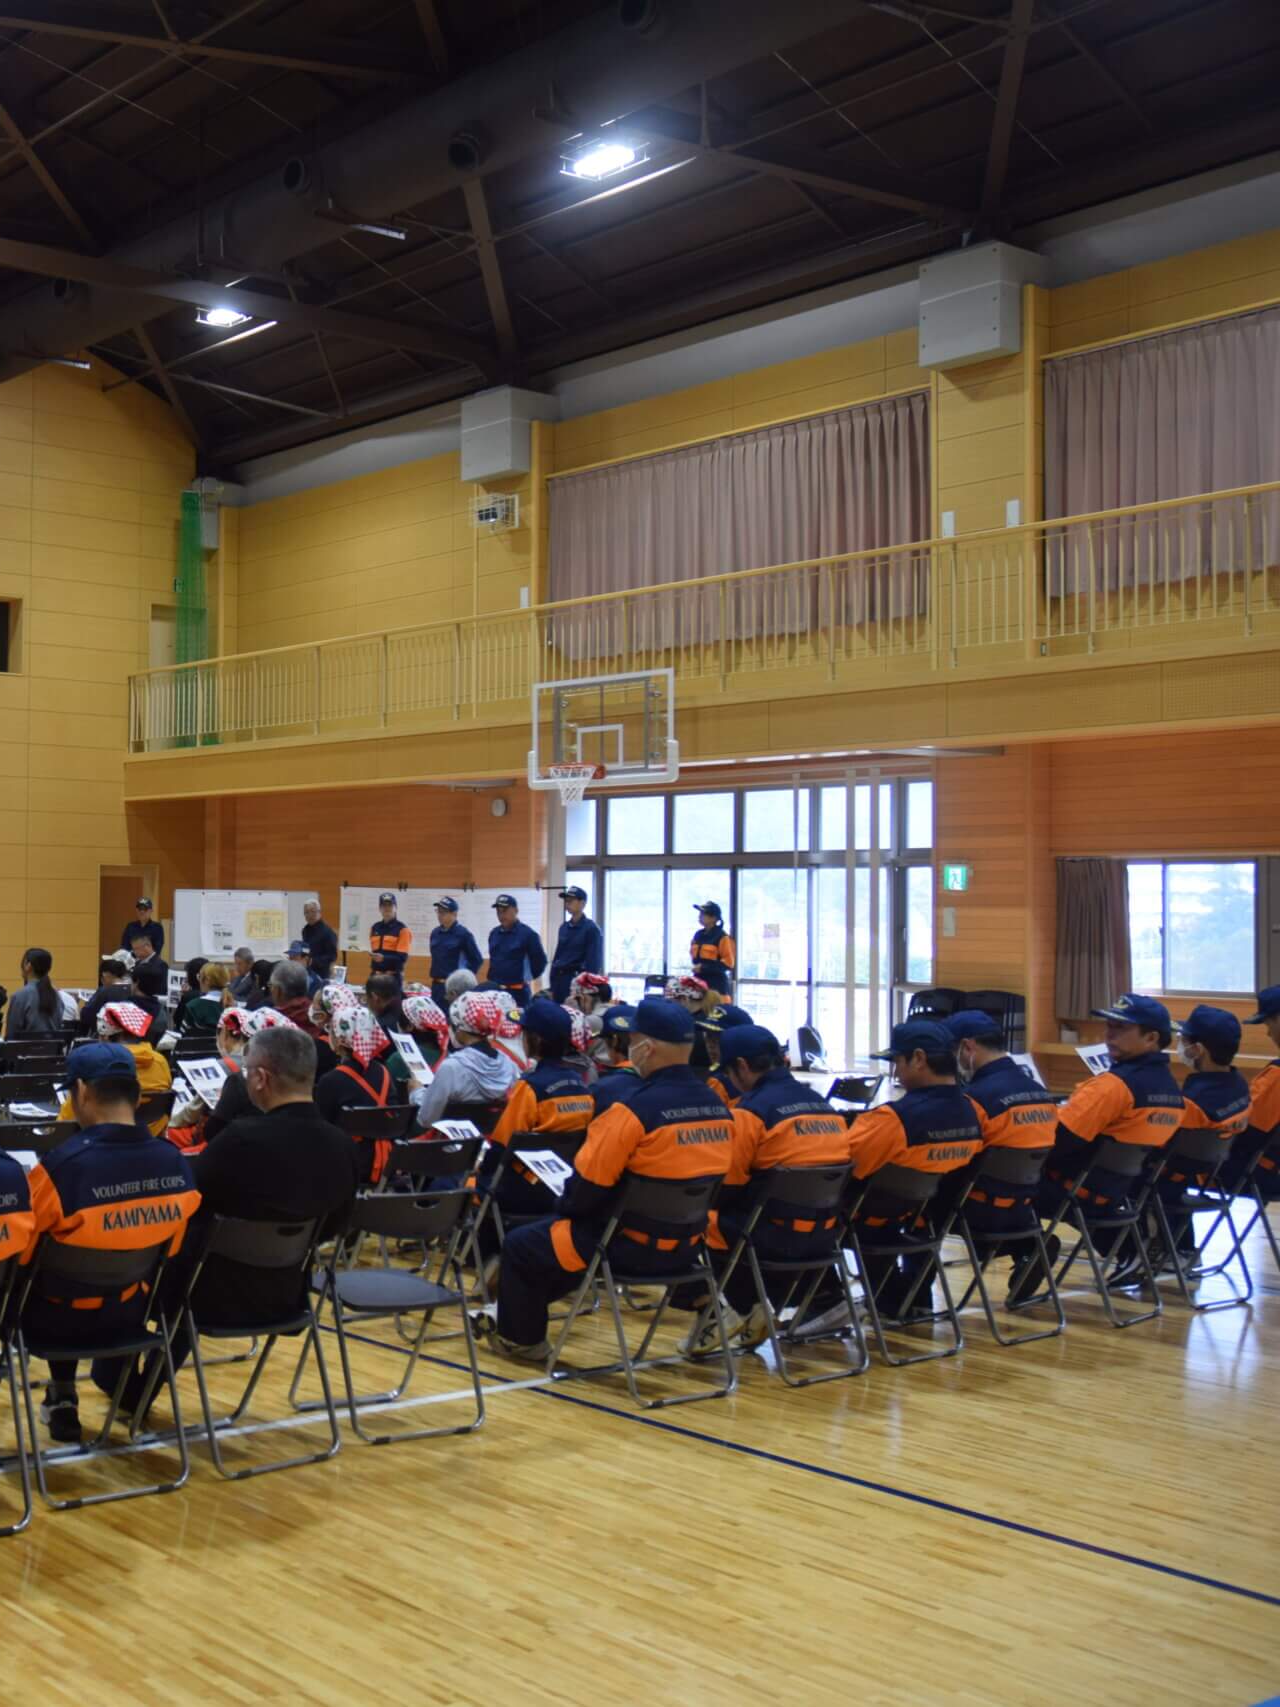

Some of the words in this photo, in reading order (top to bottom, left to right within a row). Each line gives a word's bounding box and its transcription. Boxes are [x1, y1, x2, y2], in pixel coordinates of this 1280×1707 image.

[677, 1126, 729, 1145] KAMIYAMA
[92, 1181, 141, 1199] VOLUNTEER
[142, 1177, 160, 1191] FIRE
[160, 1175, 187, 1189] CORPS
[103, 1202, 182, 1231] KAMIYAMA
